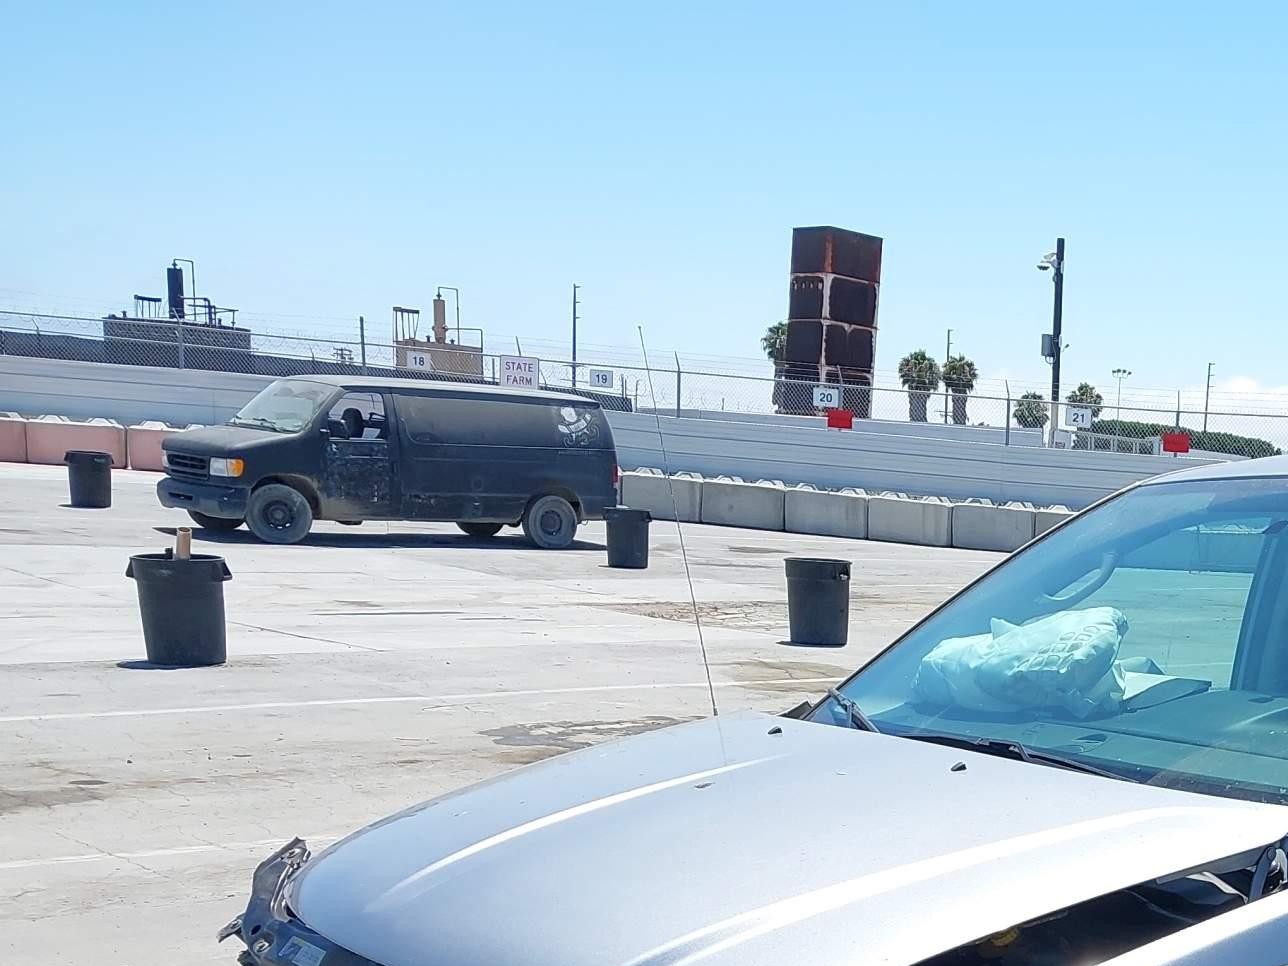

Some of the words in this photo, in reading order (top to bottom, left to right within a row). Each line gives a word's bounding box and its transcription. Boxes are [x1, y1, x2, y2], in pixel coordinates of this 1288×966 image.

[412, 356, 425, 366] 18
[505, 361, 534, 373] STATE
[506, 374, 533, 386] FARM
[595, 374, 608, 384] 19
[819, 392, 833, 403] 20
[1072, 412, 1086, 423] 21
